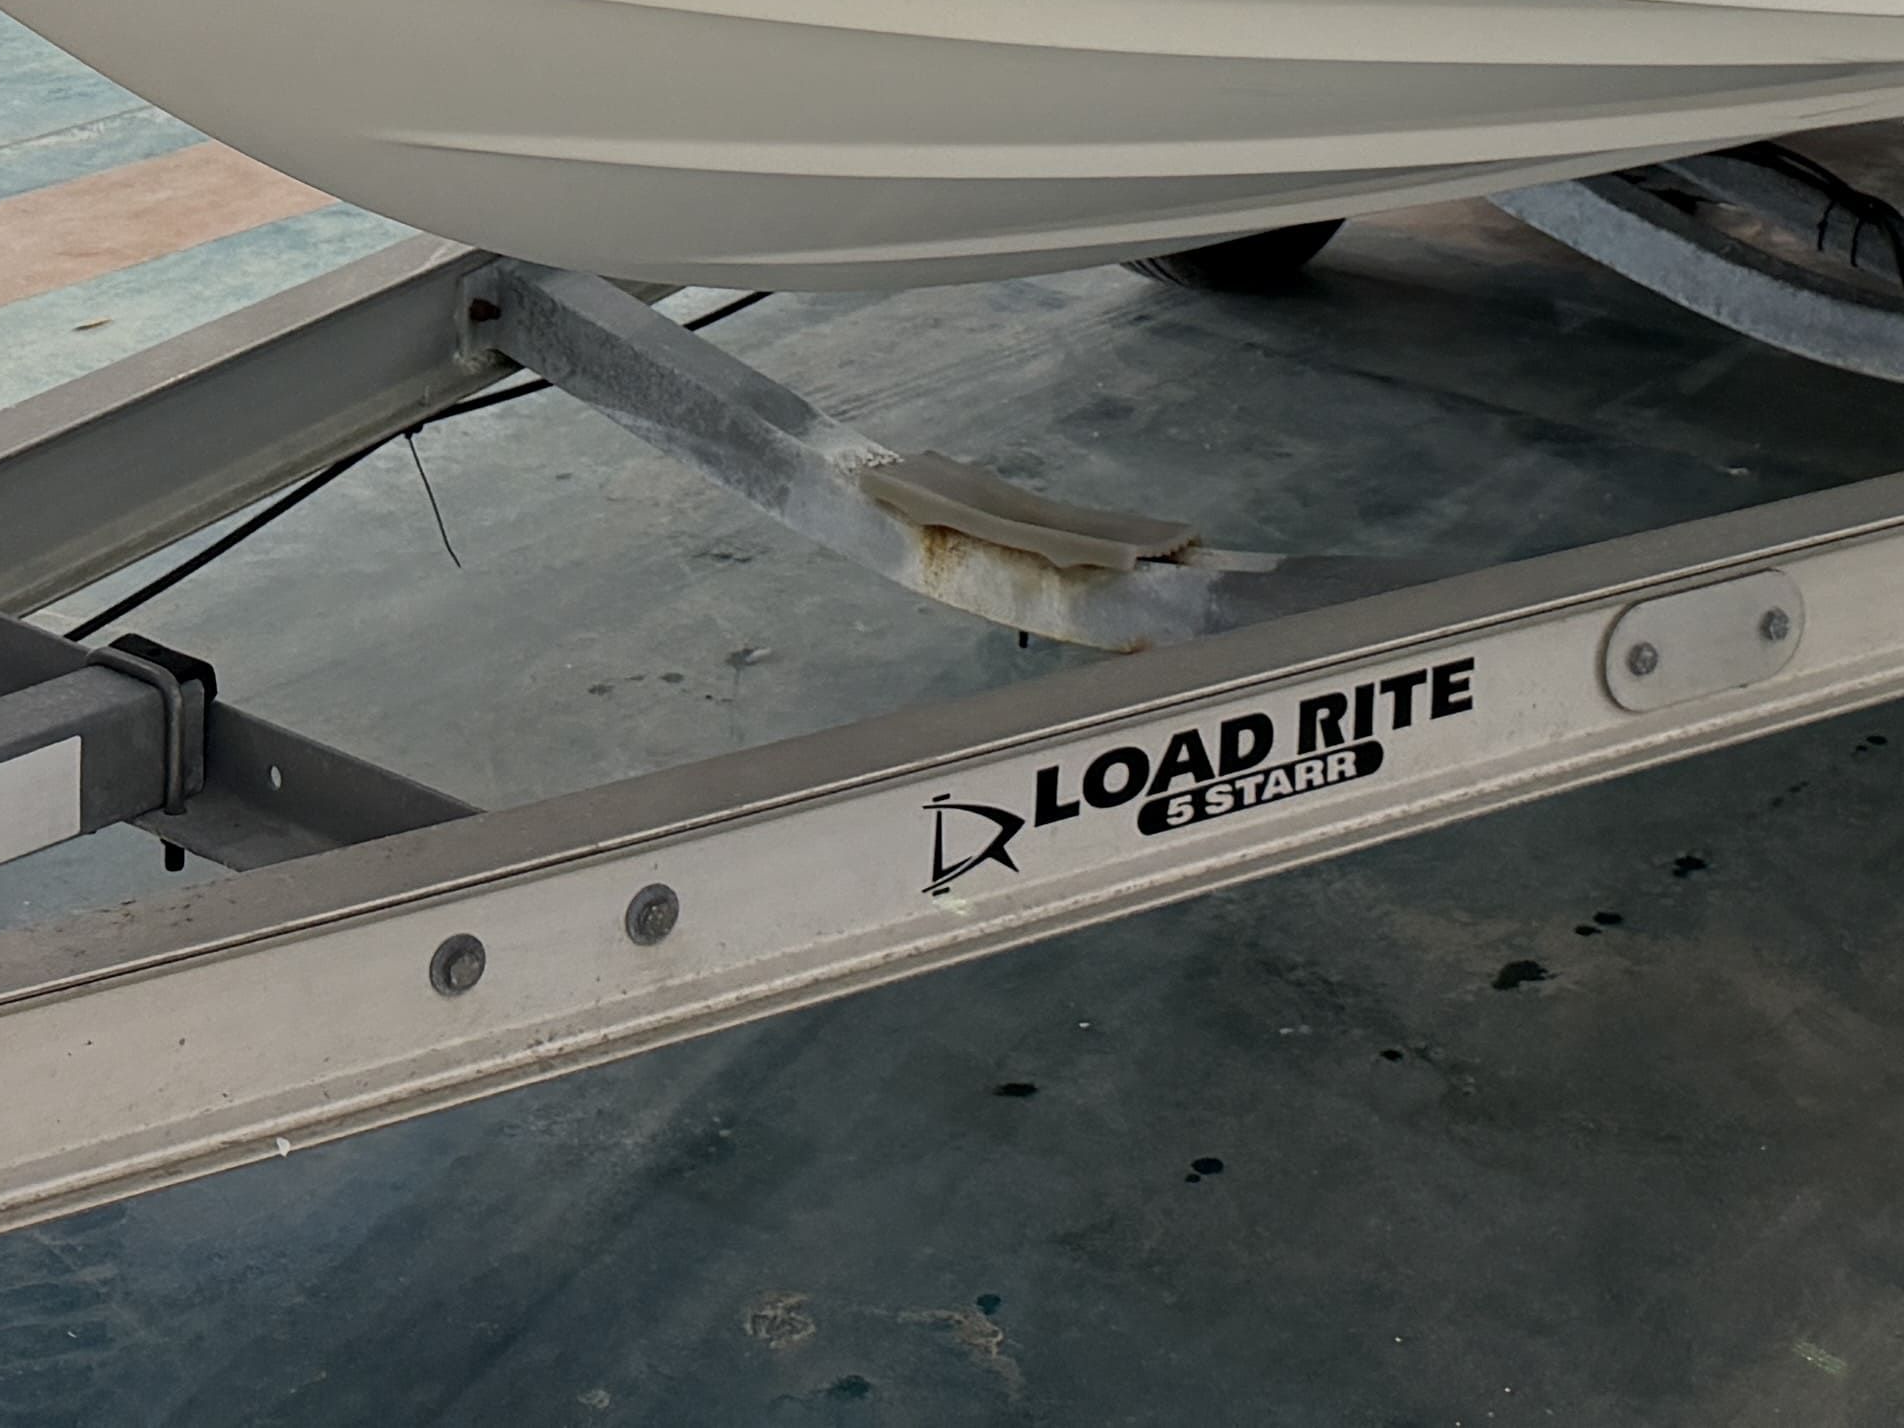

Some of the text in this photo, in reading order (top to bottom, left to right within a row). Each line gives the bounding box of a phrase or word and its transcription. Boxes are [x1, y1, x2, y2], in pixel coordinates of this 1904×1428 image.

[1034, 657, 1475, 828] LOAD RITE
[1166, 750, 1359, 826] 5 STARR
